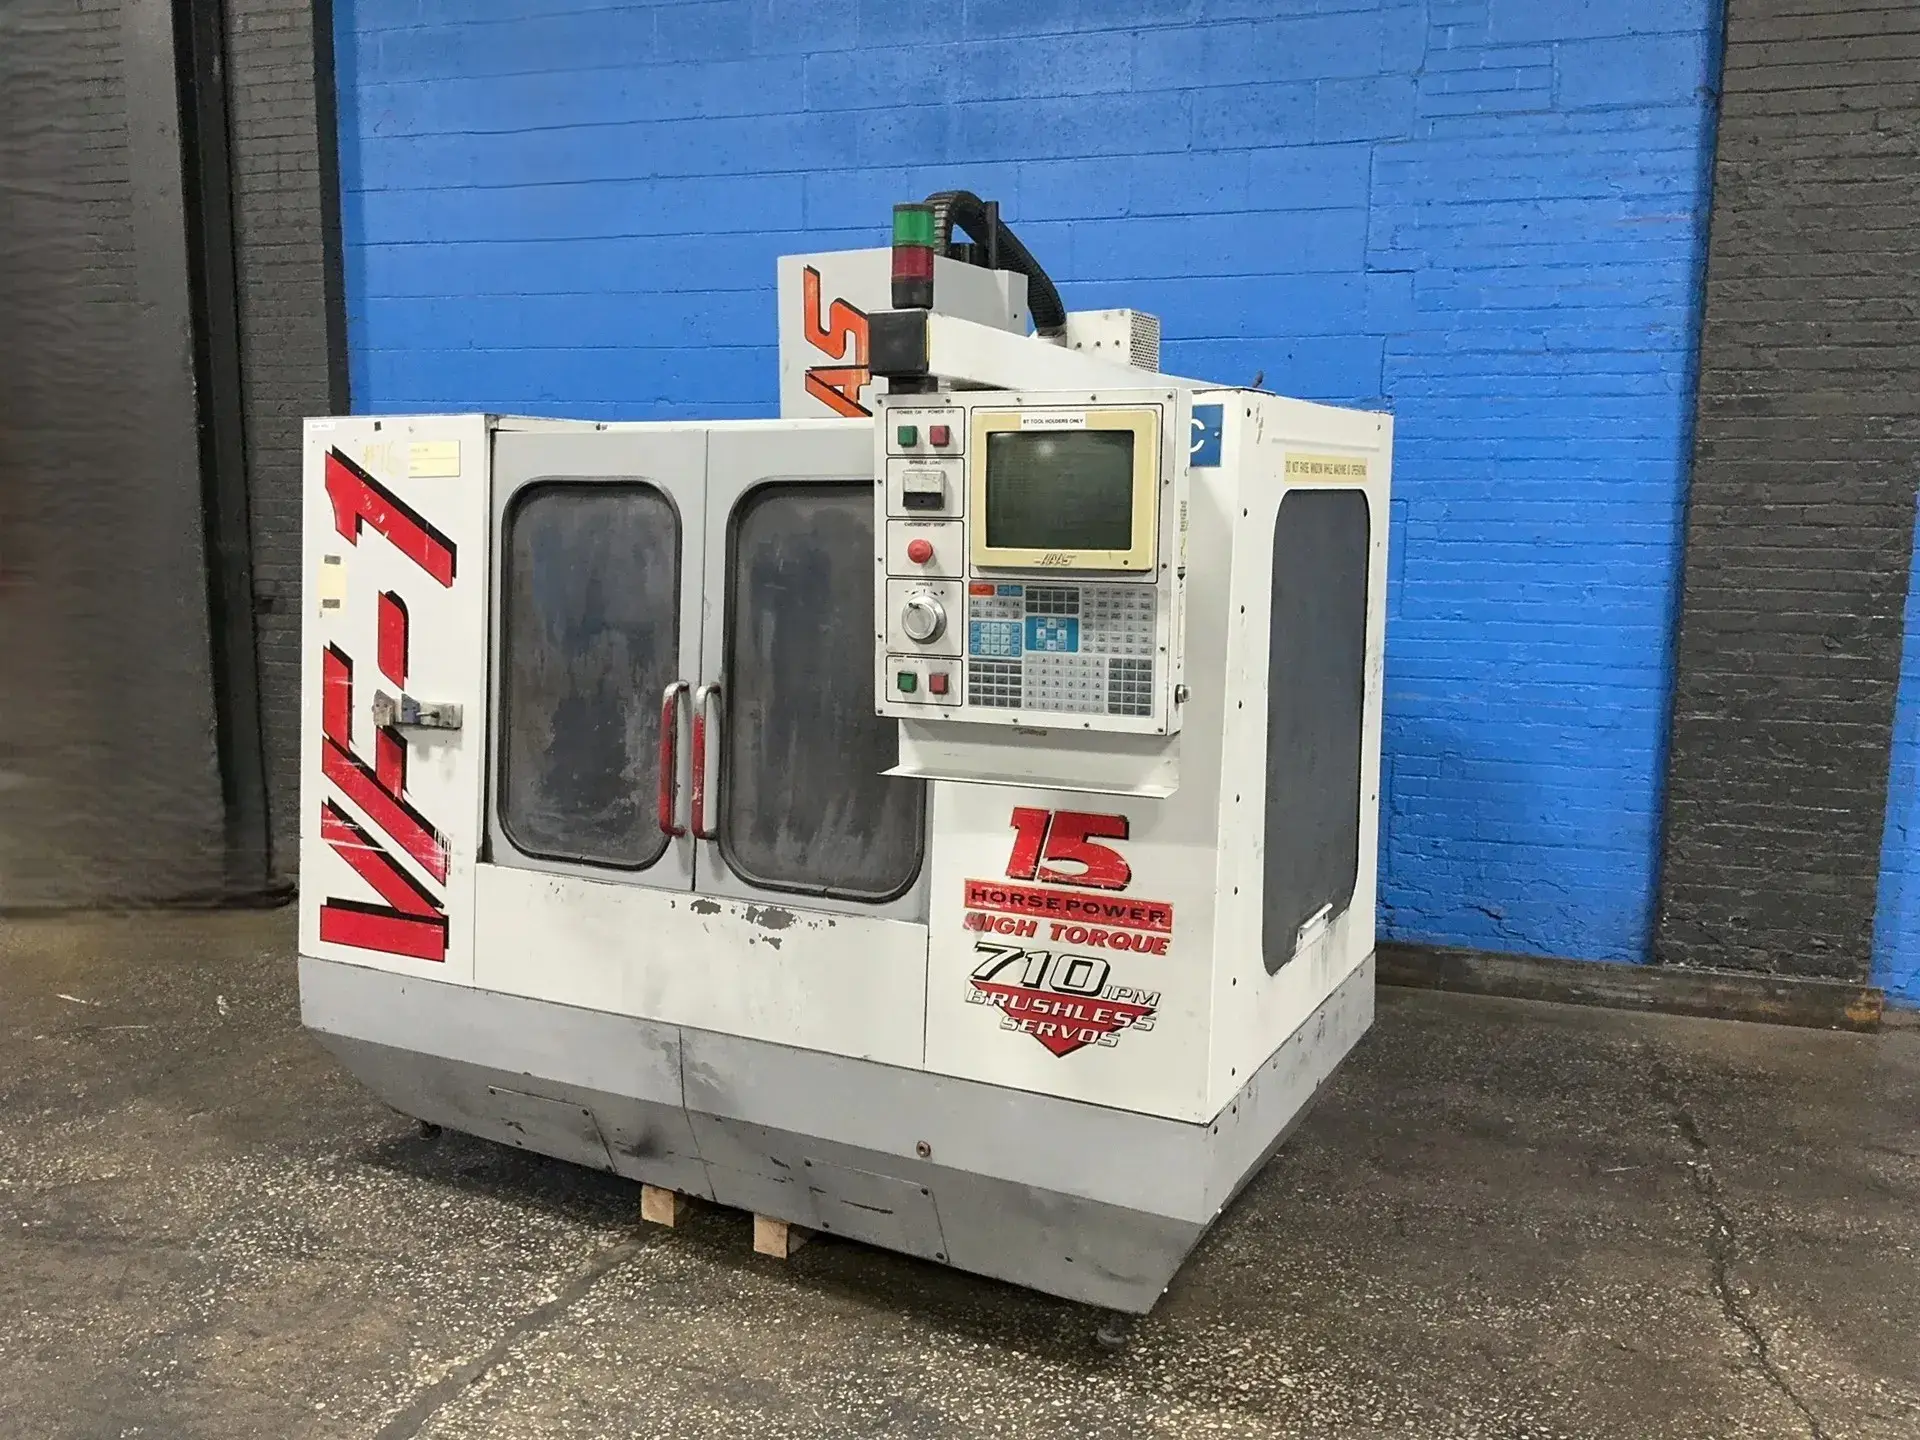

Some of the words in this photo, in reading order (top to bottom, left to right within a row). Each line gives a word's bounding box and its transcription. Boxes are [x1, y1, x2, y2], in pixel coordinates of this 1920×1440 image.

[1005, 806, 1132, 891] 15
[970, 888, 1166, 923] HORSEPOWER
[963, 912, 1037, 938] HIGH
[1050, 923, 1172, 956] TORQUE
[971, 942, 1110, 996] 710
[1101, 984, 1161, 1007] IPM
[965, 986, 1156, 1031] BRUSHLESS
[1000, 1015, 1120, 1048] SERVOS
